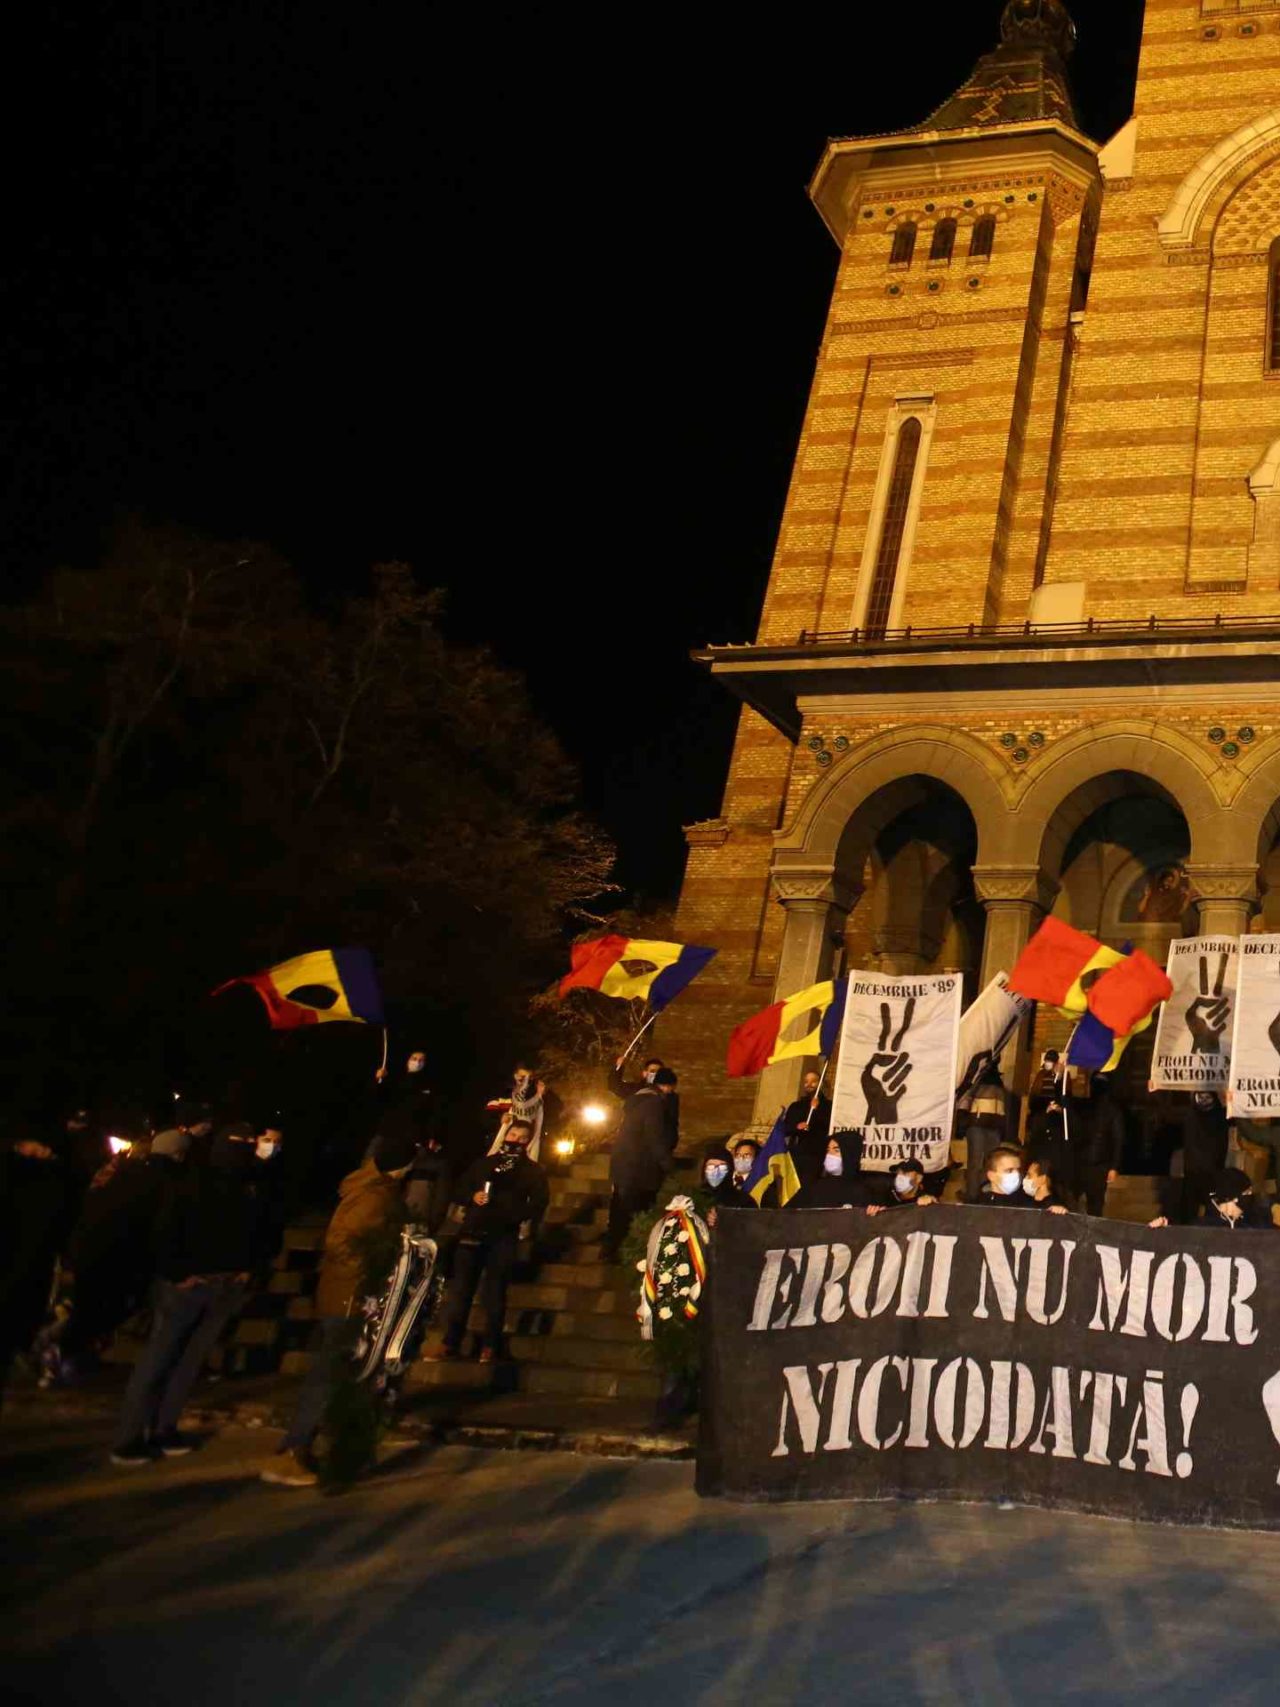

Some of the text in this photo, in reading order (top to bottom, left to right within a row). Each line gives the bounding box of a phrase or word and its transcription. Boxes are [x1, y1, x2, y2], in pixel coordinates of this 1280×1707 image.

[853, 982, 928, 998] DECEMBRIE
[1199, 1055, 1218, 1068] NU
[1163, 1068, 1230, 1081] NICIODA
[872, 1127, 896, 1141] NU
[902, 1126, 942, 1142] MOR
[861, 1143, 932, 1160] IODATA
[746, 1230, 1260, 1346] EROII NU MOR
